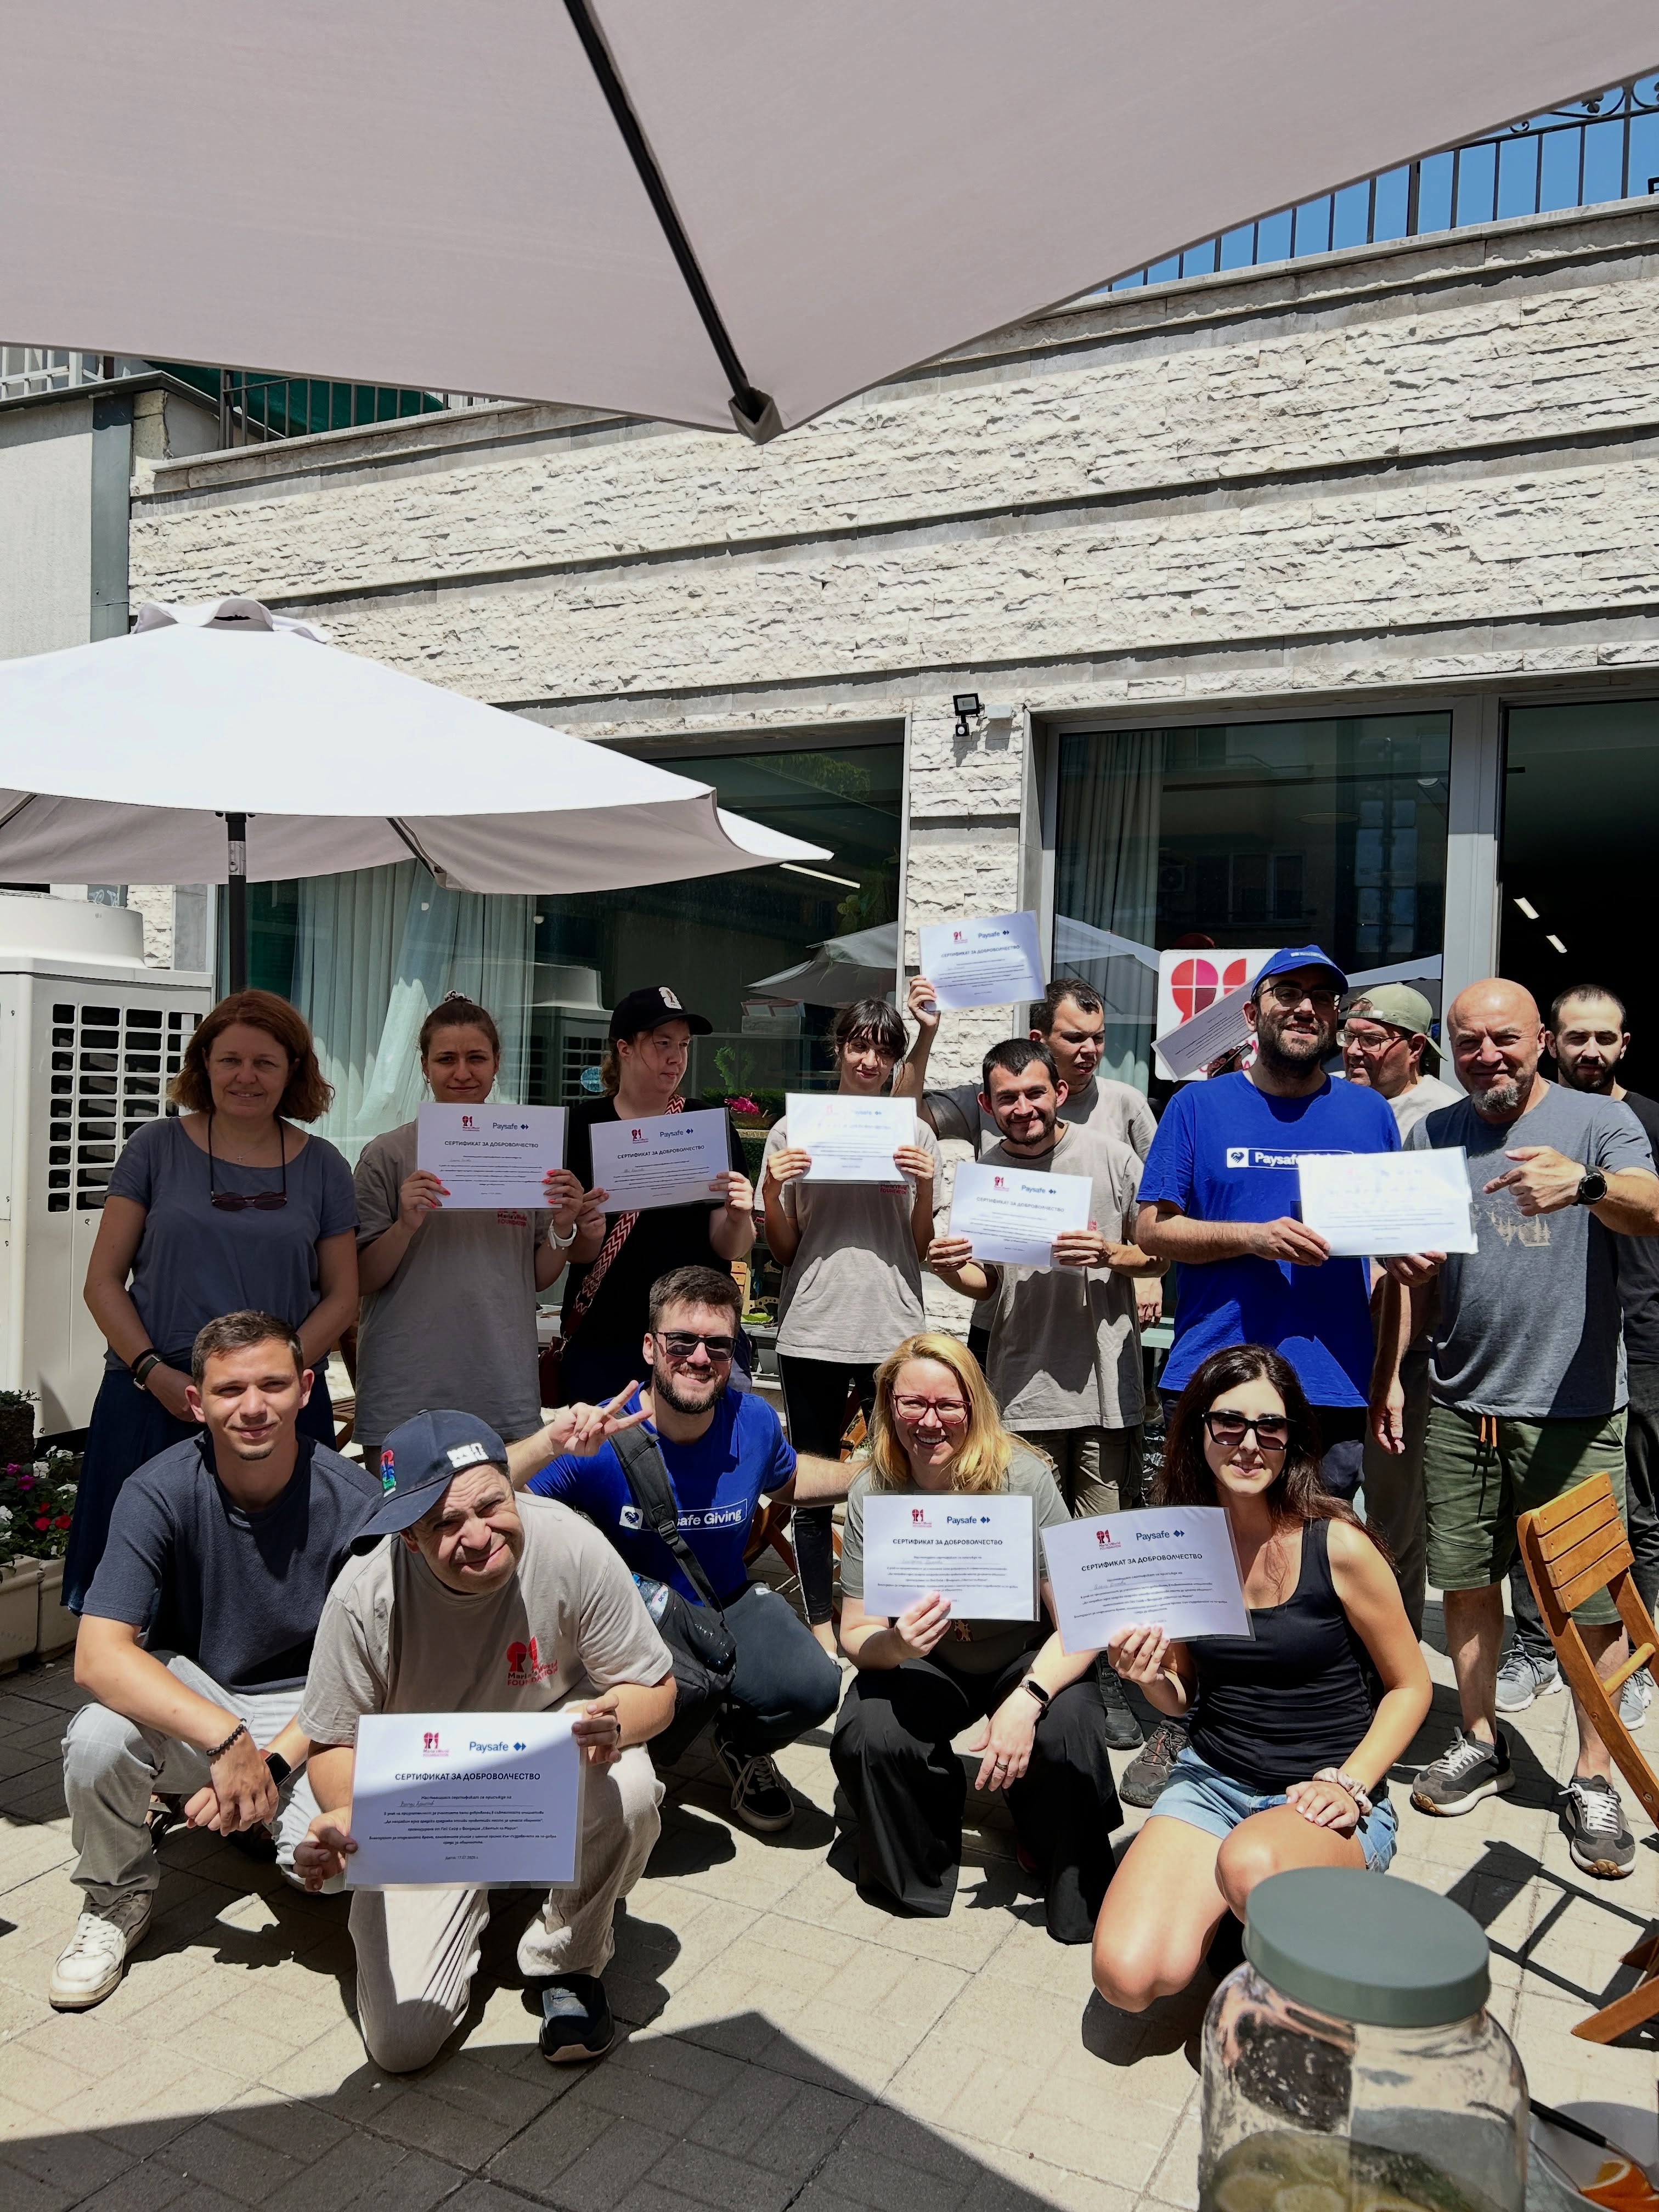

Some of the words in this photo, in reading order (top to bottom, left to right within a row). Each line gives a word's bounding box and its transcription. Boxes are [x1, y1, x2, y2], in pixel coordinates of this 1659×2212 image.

[978, 932, 1000, 940] Paysafe
[493, 1122, 518, 1131] Paysafe
[659, 1130, 684, 1138] Paysafe
[617, 1151, 651, 1159] СЕРТИФИКАТ
[658, 1145, 705, 1155] ДОБРОВОЛЧЕСТВО
[1255, 1152, 1299, 1167] Paysaf
[1022, 1185, 1046, 1194] Paysafe
[704, 1509, 742, 1525] Giving
[947, 1516, 977, 1526] Paysafe
[1136, 1530, 1170, 1542] Paysafe
[1081, 1559, 1126, 1572] СЕРТИФИКАТ
[1137, 1553, 1203, 1564] ДОБРОВОЛЧЕСТВО
[507, 1666, 558, 1686] FOUNDATION
[469, 1741, 509, 1754] Paysafe
[395, 1773, 450, 1781] СЕРТИФИКАТ
[462, 1773, 541, 1782] ДОБРОВОЛЧЕСТВО
